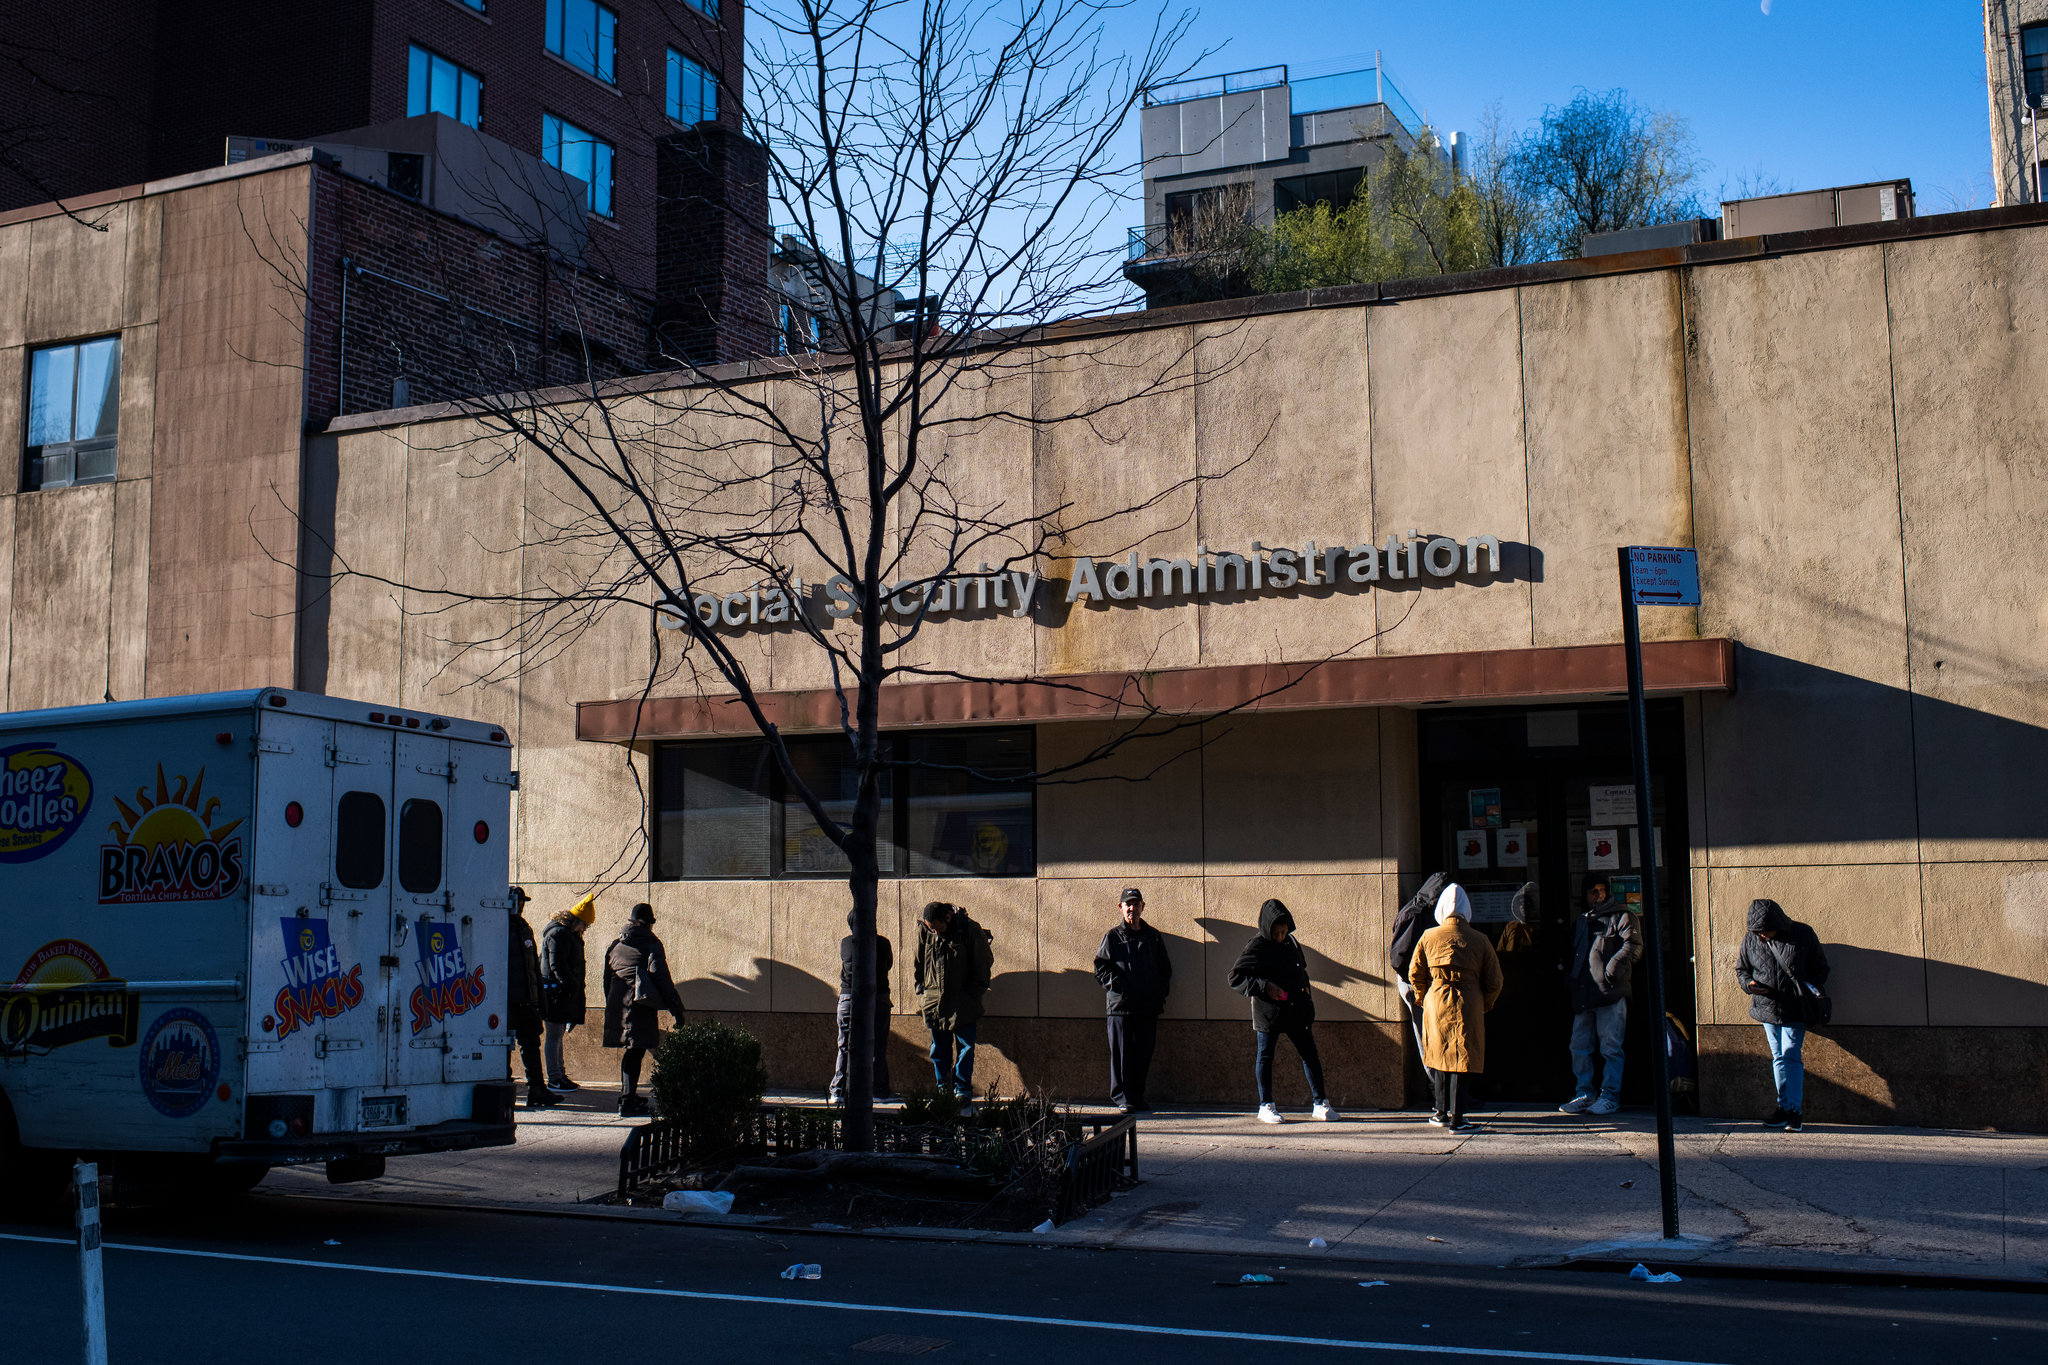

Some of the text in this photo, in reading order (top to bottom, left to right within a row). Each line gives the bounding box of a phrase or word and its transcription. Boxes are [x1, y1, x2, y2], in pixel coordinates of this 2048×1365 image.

[266, 142, 294, 152] YORK
[1065, 528, 1501, 603] Administration
[1633, 551, 1682, 564] NO PARKING
[1635, 566, 1648, 575] 8am
[1654, 567, 1667, 576] 6pm
[1636, 577, 1680, 588] Except Sunday
[0, 793, 74, 829] odles
[12, 831, 42, 847] Snacks
[100, 840, 241, 899] BRAVOS
[120, 893, 157, 903] TORTILLA
[158, 891, 181, 901] CHIPS
[183, 890, 189, 900] &
[38, 945, 66, 964] BAKED
[67, 942, 104, 975] PRETZELS
[282, 945, 340, 988] WISE
[416, 947, 466, 988] WISE
[276, 963, 364, 1040] SNACKS
[410, 965, 486, 1035] SNACKS
[156, 1050, 202, 1081] Mets
